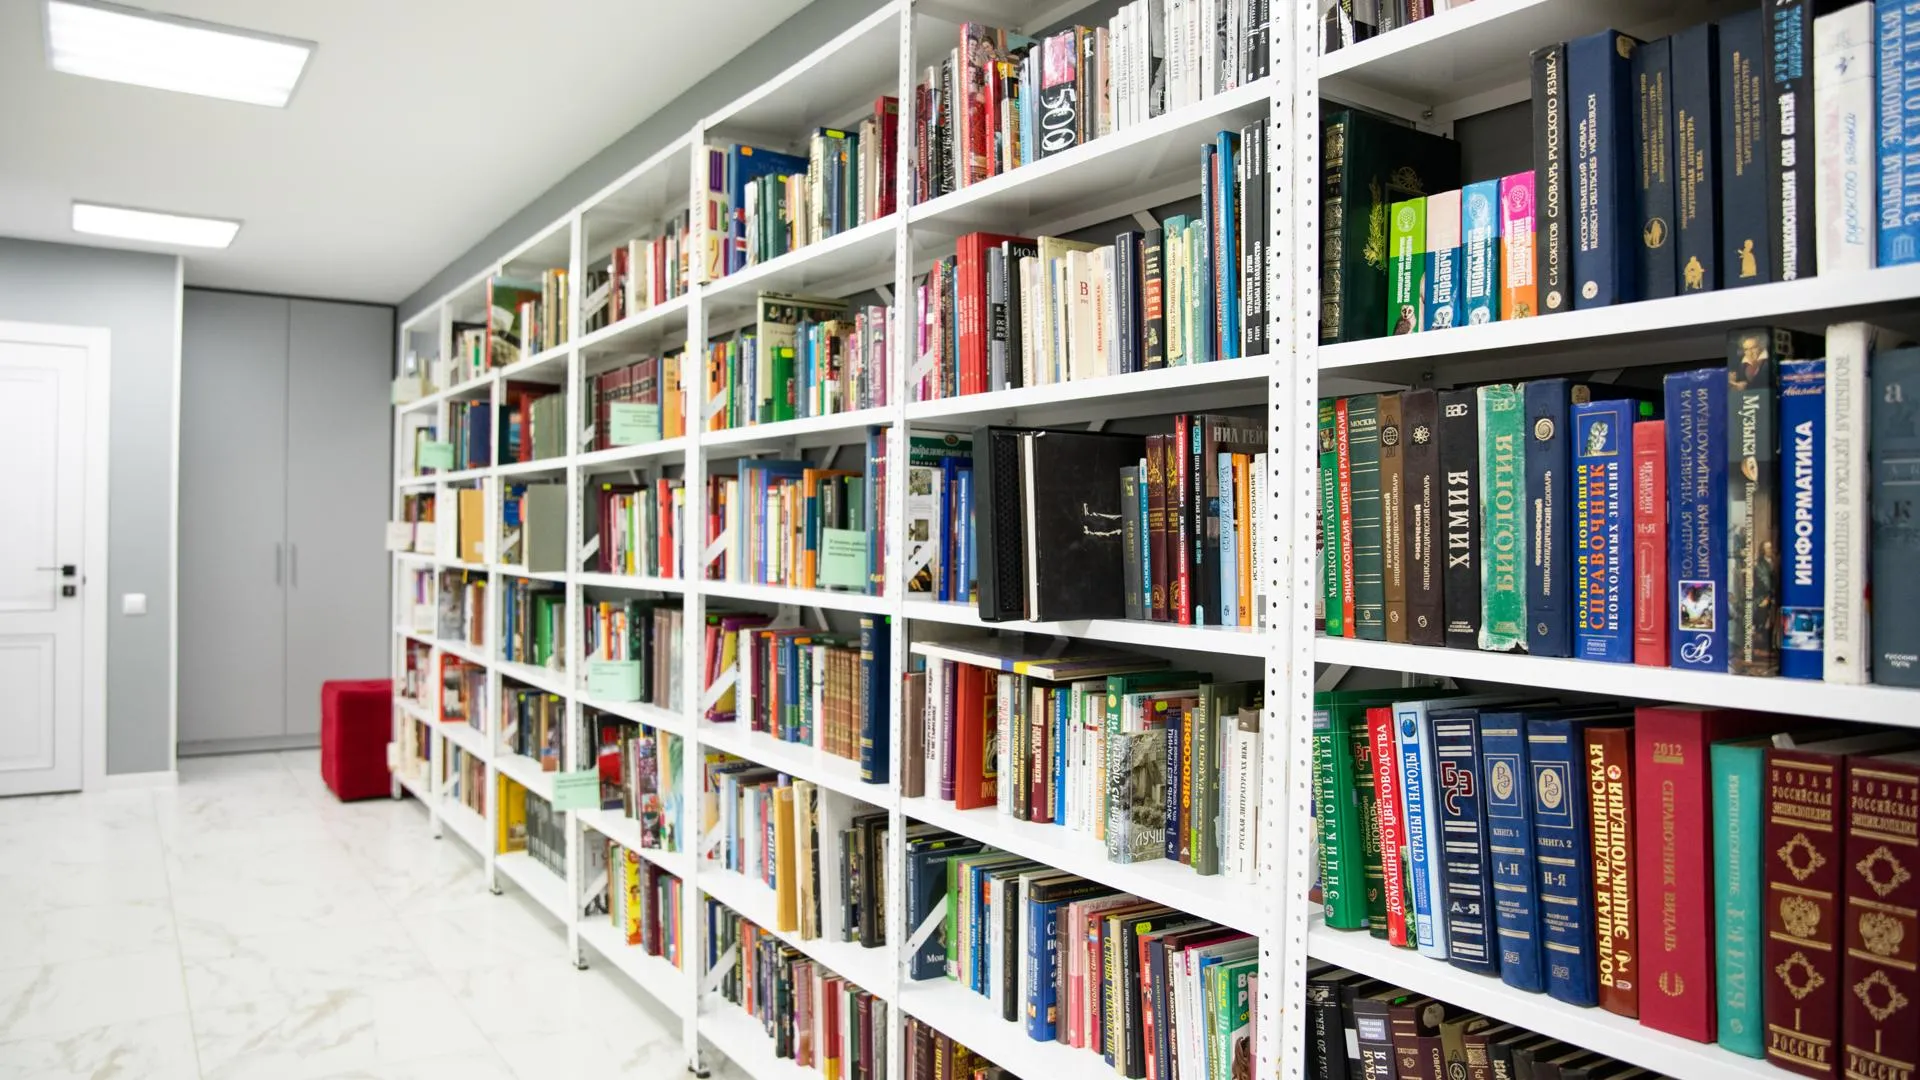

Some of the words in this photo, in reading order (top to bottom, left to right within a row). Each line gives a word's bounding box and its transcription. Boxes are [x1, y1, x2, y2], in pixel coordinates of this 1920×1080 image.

[1546, 51, 1557, 95] ЯЗЫКА
[1880, 9, 1903, 148] ЭКОНОМИЧЕСКАЯ
[1546, 98, 1558, 160] РУССКОГО
[1587, 94, 1597, 153] WÖRTERBUCH
[1778, 92, 1795, 136] ДЕТЕЙ
[1780, 137, 1796, 167] ДЛЯ
[1547, 163, 1558, 217] СЛОВАРЬ
[1579, 162, 1588, 252] РУССКО-НЕМЕЦКИЙ
[1589, 157, 1598, 249] RUSSISCH-DEUTSCHES
[1881, 154, 1903, 230] БОЛЬШАЯ
[1549, 223, 1558, 286] С.И.ОЖЕГОВ
[1781, 170, 1797, 280] ЭНЦИКЛОПЕДИЯ
[1738, 394, 1760, 456] Музыка
[1834, 355, 1851, 432] БОЛЬШАЯ
[1213, 426, 1238, 443] НИЛ
[1337, 409, 1347, 469] РУКОДЕЛИЕ
[1680, 388, 1693, 505] УНИВЕРСАЛЬНАЯ
[1697, 388, 1709, 497] ЭНЦИКЛОПЕДИЯ
[1339, 482, 1350, 514] ШИТЬЕ
[1495, 434, 1514, 592] БИОЛОГИЯ
[1577, 463, 1587, 549] НОВЕЙШИЙ
[1607, 461, 1618, 518] ЗНАНИЙ
[1642, 461, 1654, 514] ПИСАТЕЛИ
[1795, 421, 1813, 585] ИНФОРМАТИКА
[1324, 468, 1337, 597] МЛЕКОПИТАЮЩИЕ
[1384, 493, 1392, 568] ГЕОГРАФИЧЕСКИЙ
[1448, 470, 1470, 569] ХИМИЯ
[1589, 463, 1606, 630] СПРАВОЧНИК
[1681, 511, 1693, 578] БОЛЬШАЯ
[1697, 504, 1709, 578] ШКОЛЬНАЯ
[1343, 516, 1352, 603] ЭНЦИКЛОПЕДИЯ.
[1608, 523, 1619, 631] НЕОБХОДИМЫХ
[1577, 555, 1587, 629] БОЛЬШОЙ
[1183, 712, 1192, 808] ФИЛОСОФИЯ
[1377, 724, 1396, 826] ЦВЕТОВОДСТВА
[1405, 752, 1420, 801] НАРОДЫ
[1653, 743, 1683, 756] 2012
[1772, 769, 1832, 790] НОВАЯ
[1239, 772, 1247, 817] ЛИТЕРАТУРА
[1312, 735, 1325, 838] ГЕОГРАФИЧЕСКАЯ
[1321, 735, 1339, 900] ЭНЦИКЛОПЕДИЯ
[1411, 804, 1420, 812] И
[1589, 743, 1611, 886] МЕДИЦИНСКАЯ
[1772, 786, 1832, 806] РОССИЙСКАЯ
[1852, 778, 1918, 801] НОВАЯ
[1852, 795, 1918, 818] РОССИЙСКАЯ
[1135, 829, 1166, 849] ЛУЧШ
[1411, 815, 1425, 862] СТРАНЫ
[1493, 827, 1513, 837] КНИГА
[1515, 828, 1520, 837] 1
[1538, 837, 1564, 848] КНИГА
[1566, 839, 1572, 848] 2
[1607, 782, 1630, 940] ЭНЦИКЛОПЕДИЯ
[1662, 780, 1675, 886] СПРАВОЧНИК
[1385, 828, 1401, 915] ДОМАШНЕГО
[1498, 862, 1519, 876] А-Н
[1544, 871, 1566, 887] Н-Я
[1596, 891, 1614, 986] БОЛЬШАЯ
[1663, 892, 1677, 952] ВИДАЛЬ
[1103, 937, 1112, 981] ОСНОВЫ
[1726, 902, 1747, 1011] БАЛЕТ
[1105, 985, 1115, 1055] ПСИХОЛОГИИ
[1316, 1009, 1325, 1036] ВЕКА
[1317, 1039, 1326, 1053] 20
[1772, 1034, 1826, 1062] РОССИЯ
